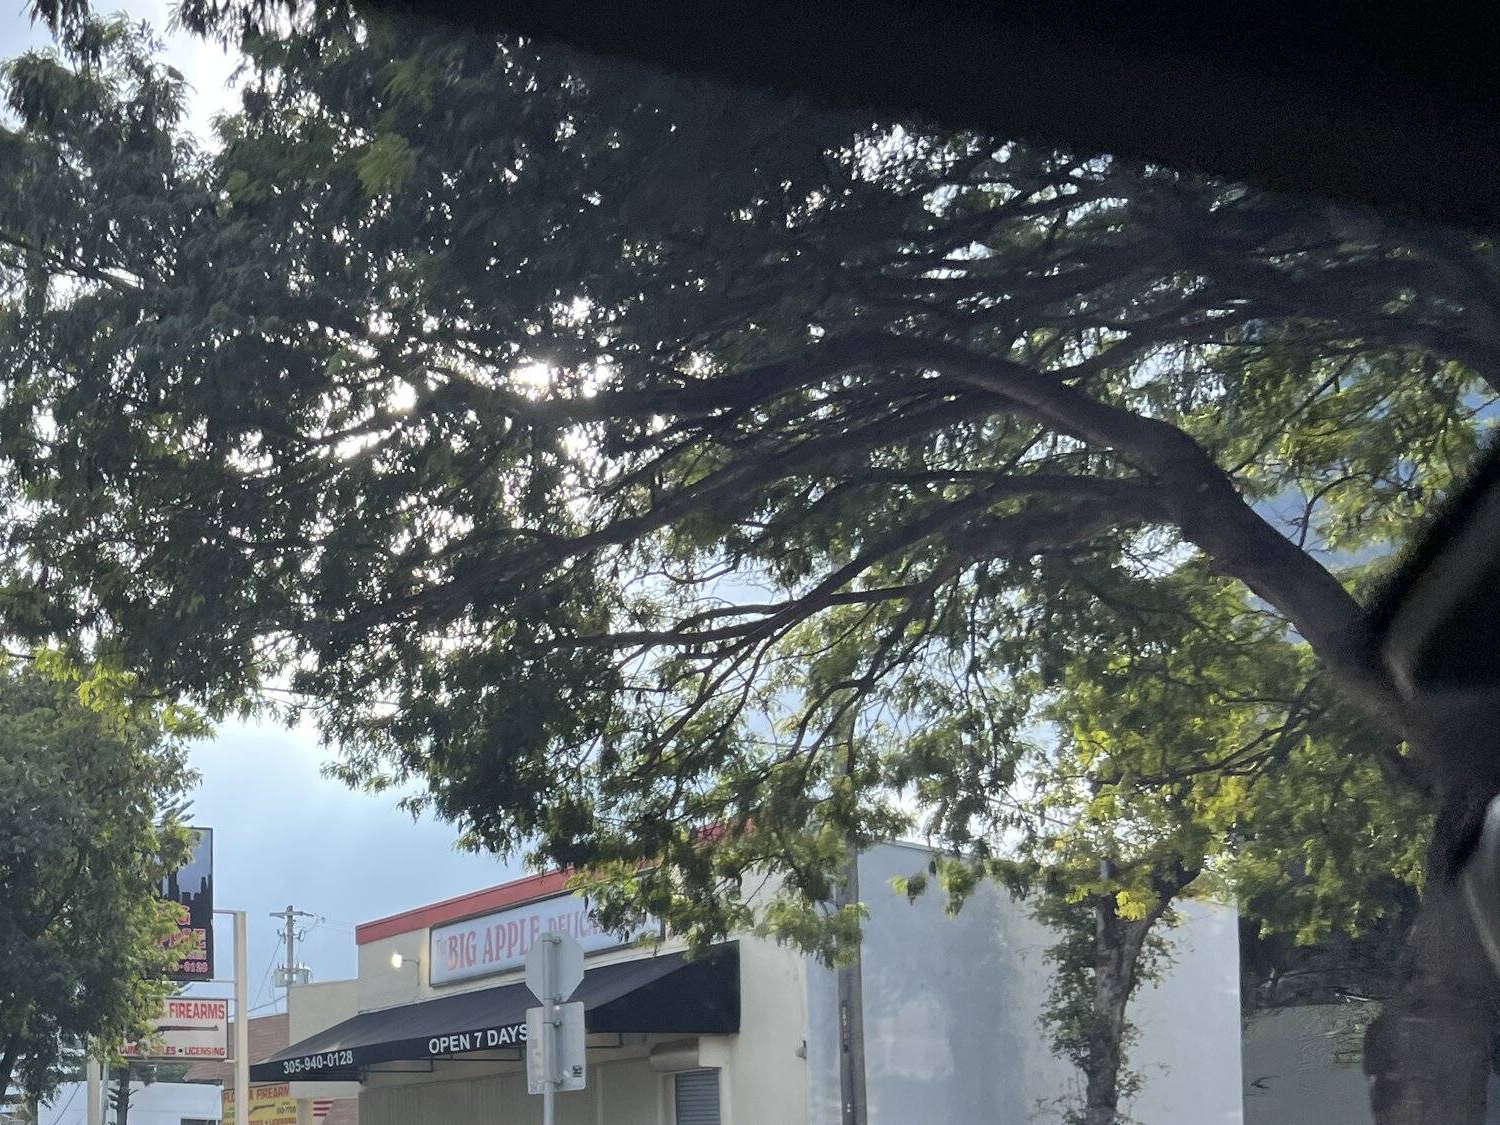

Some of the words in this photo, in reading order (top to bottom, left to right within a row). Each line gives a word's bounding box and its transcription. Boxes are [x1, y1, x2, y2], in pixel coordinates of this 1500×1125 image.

[448, 930, 477, 971] BIG
[482, 914, 541, 965] APPLE
[169, 1002, 225, 1020] FIREARMS
[184, 1046, 225, 1056] LICENSING
[429, 1032, 470, 1055] OPEN
[474, 1032, 484, 1049] 7
[487, 1024, 528, 1048] DAYS
[283, 1050, 354, 1075] 305-940-0128
